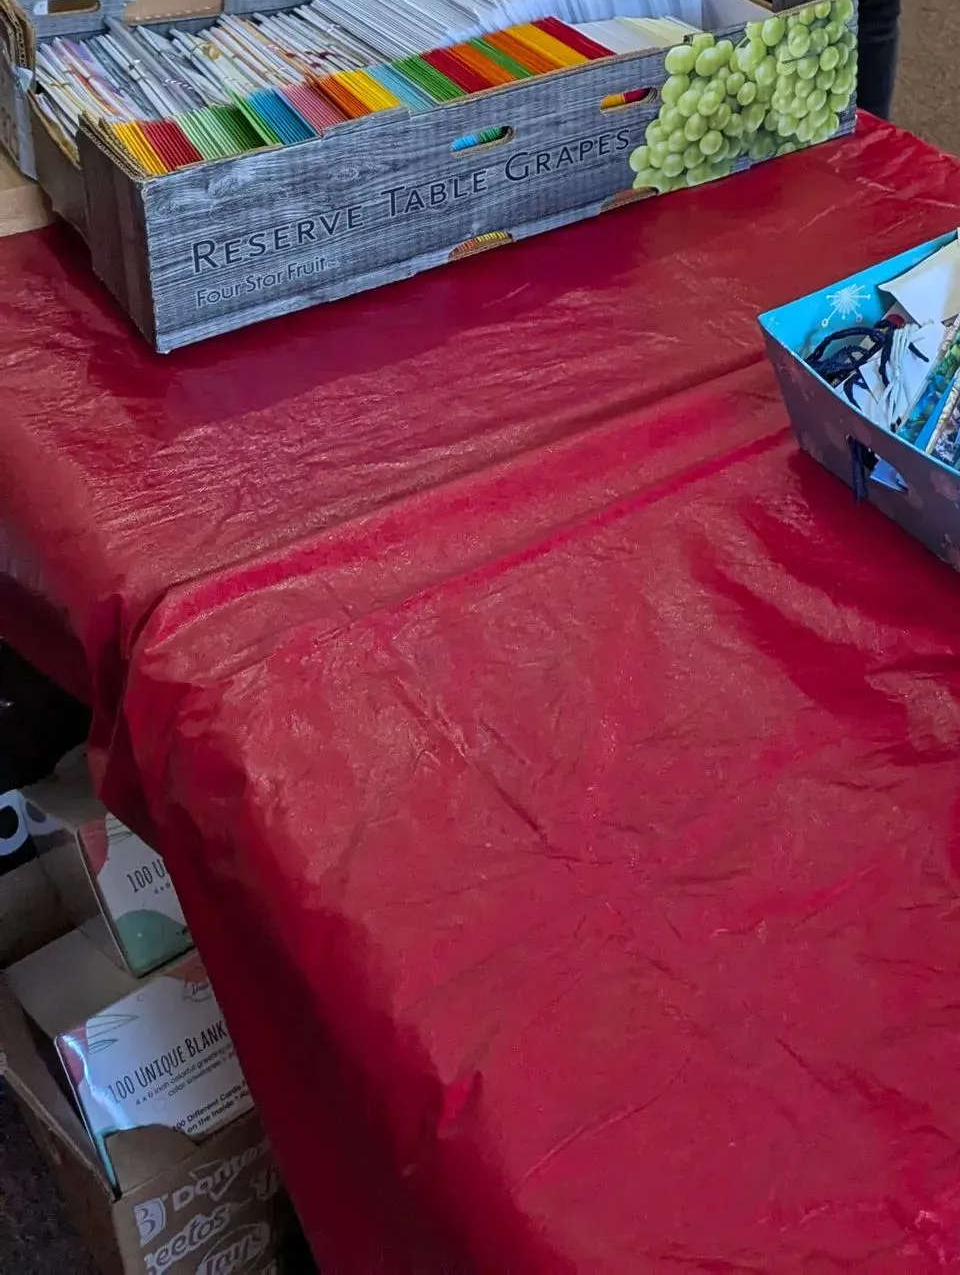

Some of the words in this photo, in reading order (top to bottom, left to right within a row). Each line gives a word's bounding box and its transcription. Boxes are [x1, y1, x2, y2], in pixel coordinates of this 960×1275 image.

[191, 207, 364, 274] RESERVE
[380, 170, 489, 217] TABLE
[504, 129, 631, 182] GRAPES
[196, 282, 242, 308] Four
[246, 271, 283, 292] Star
[287, 256, 326, 280] Fruit
[126, 865, 153, 893] 100
[107, 1074, 136, 1105] 100
[134, 1046, 187, 1089] UNIQUE
[184, 1020, 228, 1058] BLANK
[147, 1206, 230, 1275] eetos
